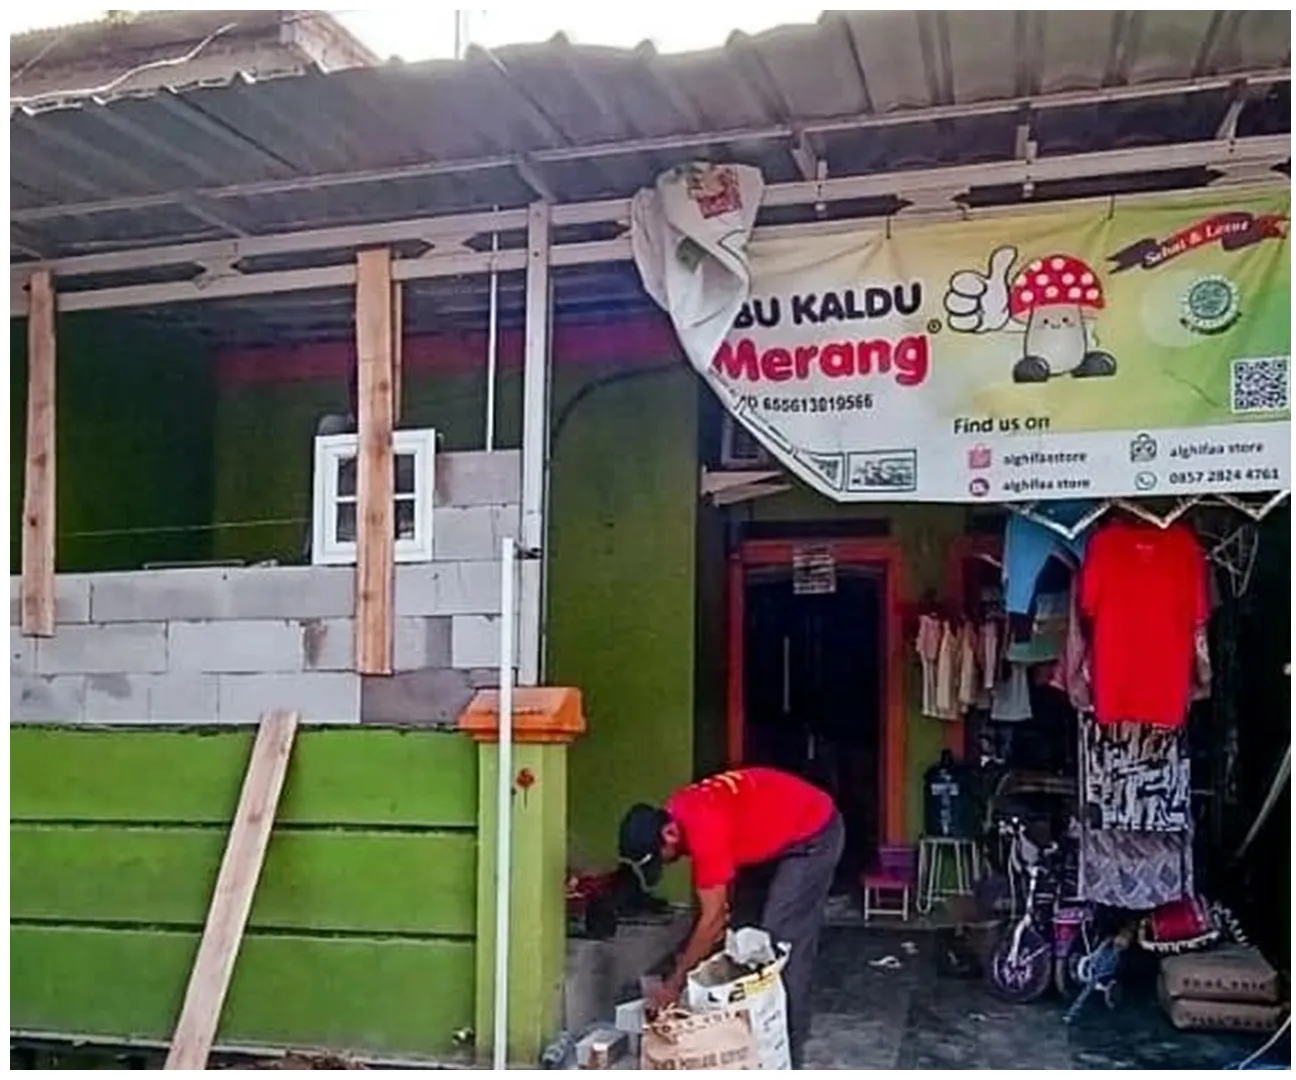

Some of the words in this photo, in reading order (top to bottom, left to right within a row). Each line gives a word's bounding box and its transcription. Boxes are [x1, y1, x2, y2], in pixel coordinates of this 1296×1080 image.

[1189, 231, 1203, 245] &
[792, 282, 922, 325] KALDU
[712, 334, 928, 386] Merang
[954, 418, 993, 434] Find
[999, 419, 1020, 432] us
[1025, 417, 1050, 430] on
[1228, 442, 1264, 453] store
